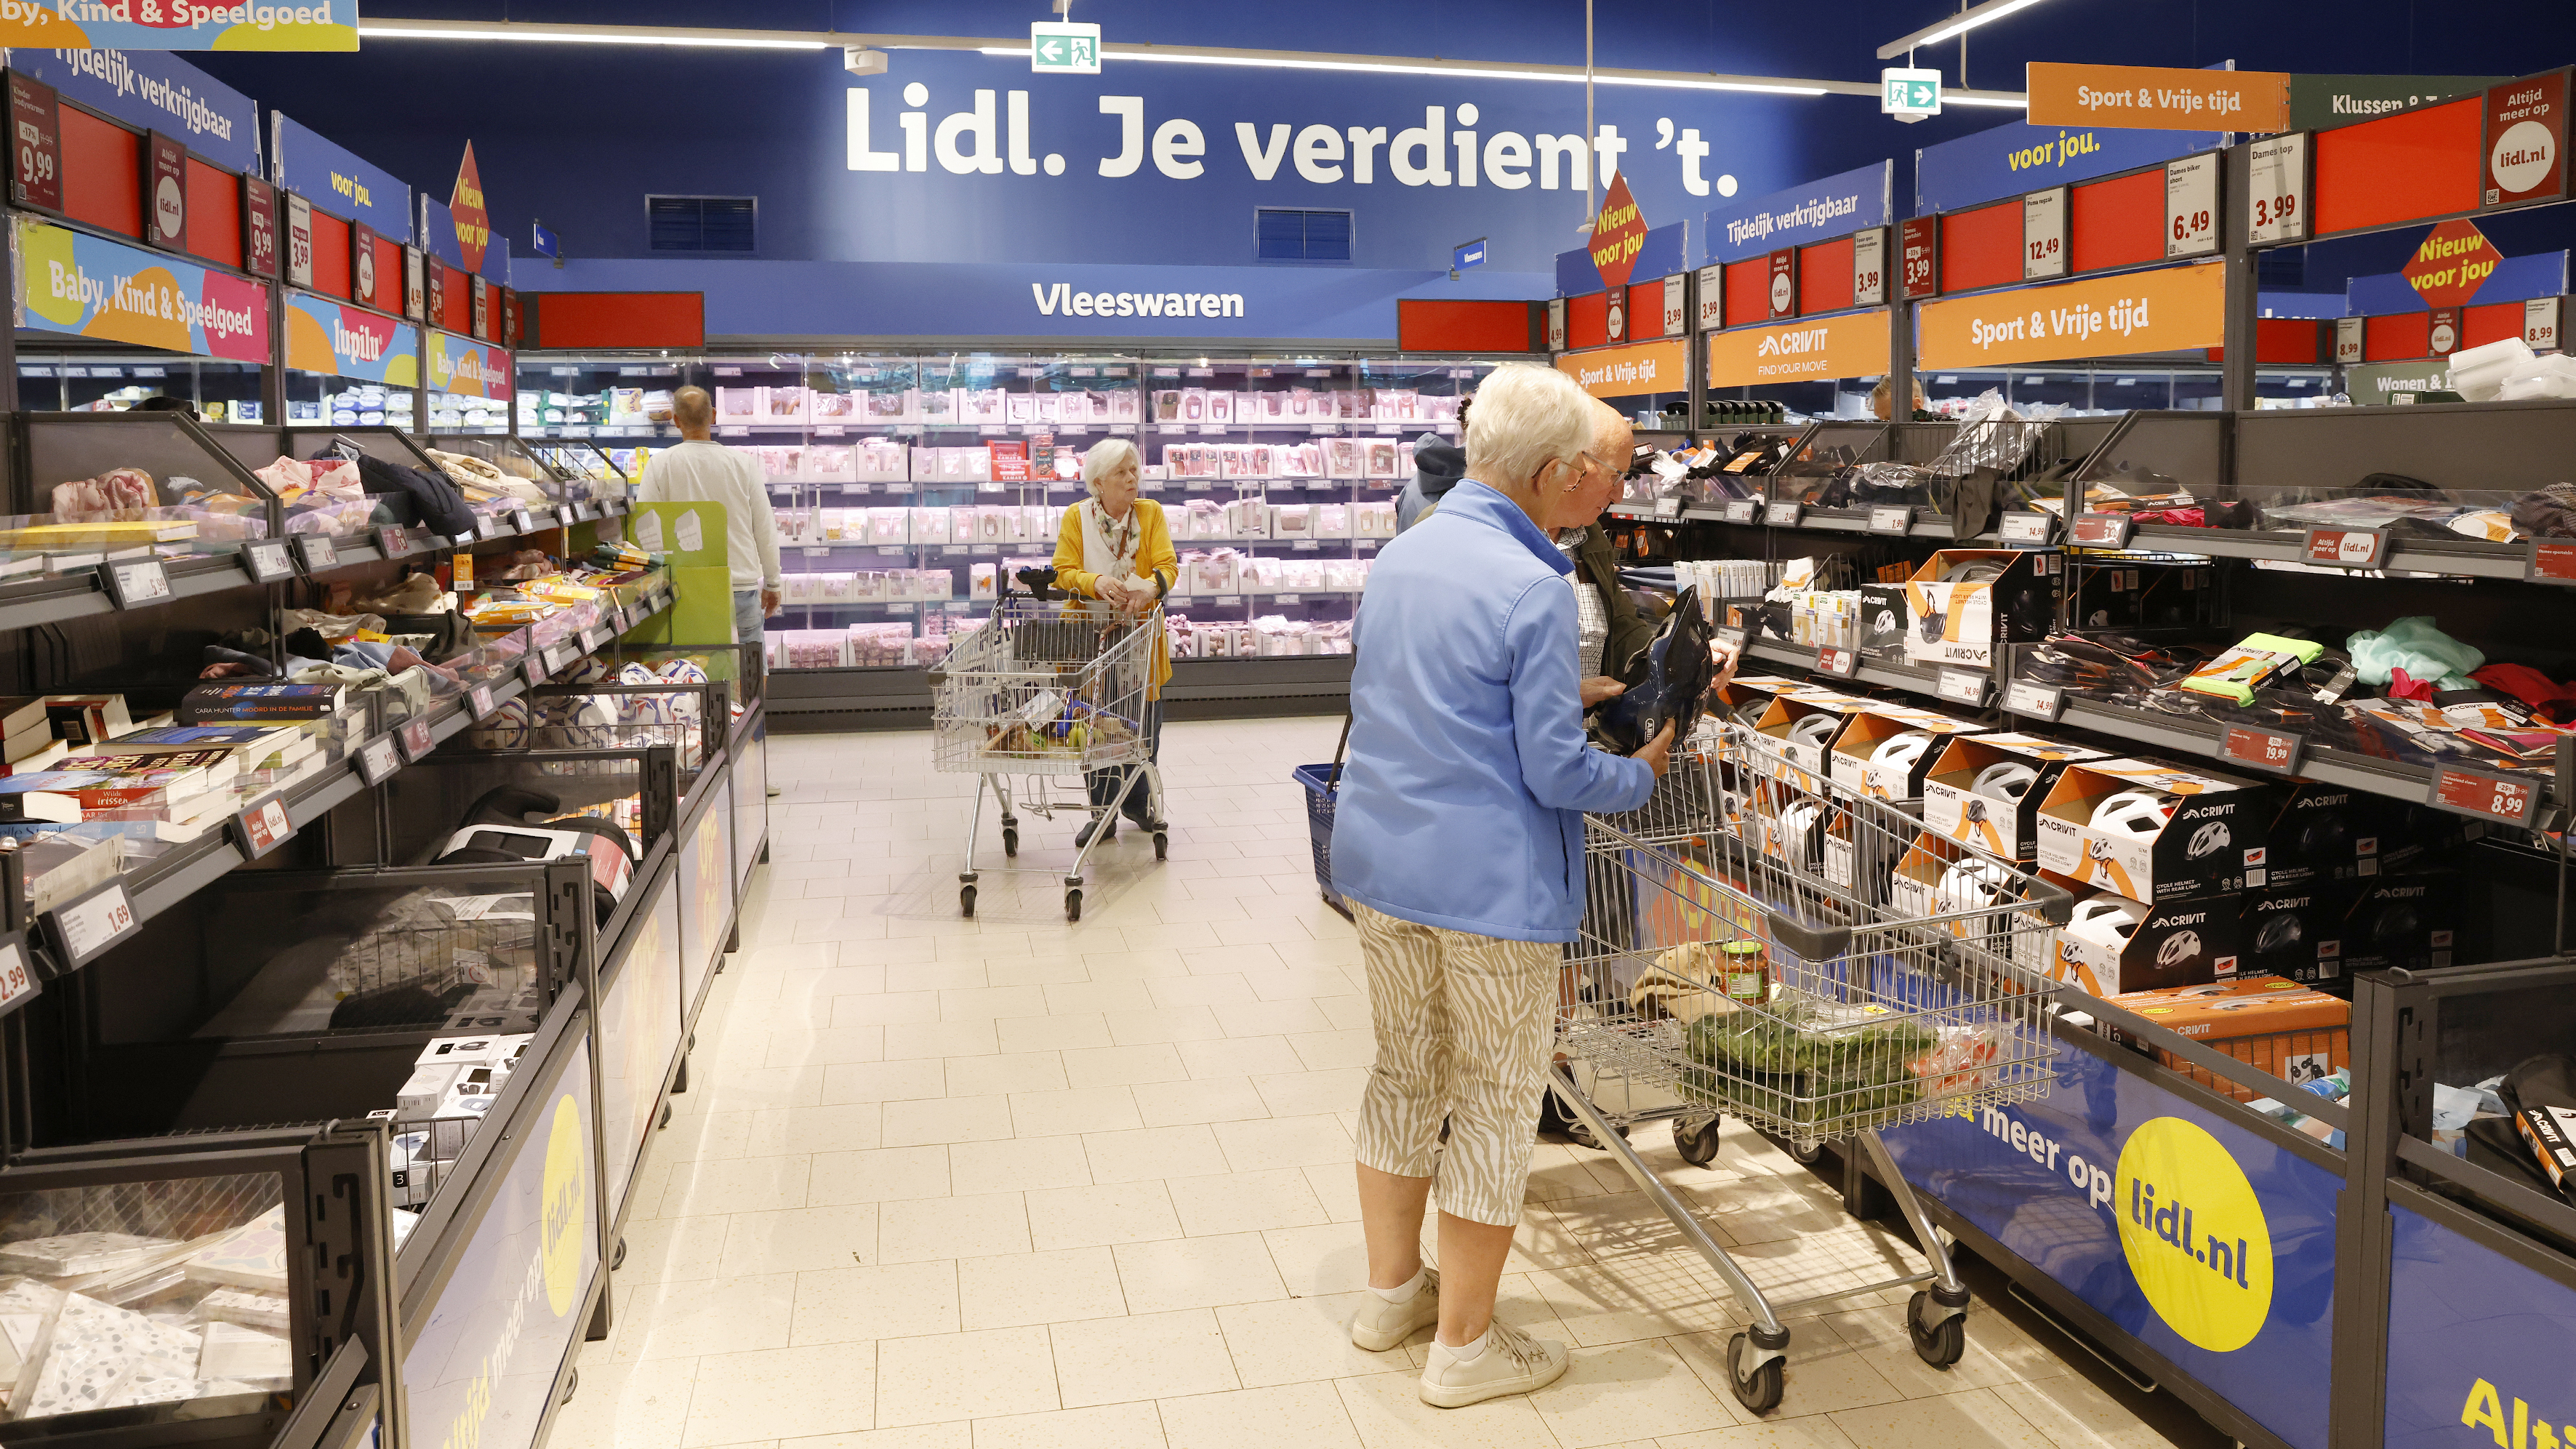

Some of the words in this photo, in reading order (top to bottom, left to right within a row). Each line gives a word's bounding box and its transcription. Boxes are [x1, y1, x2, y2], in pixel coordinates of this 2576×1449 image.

[0, 0, 48, 27] by,
[57, 0, 133, 23] Kind
[141, 1, 164, 23] &
[172, 0, 334, 31] Speelgoed
[2078, 85, 2132, 111] Sport
[2138, 88, 2153, 108] &
[2157, 89, 2204, 115] Vrije
[2208, 90, 2242, 116] tijd
[2332, 94, 2404, 115] Klussen
[2507, 87, 2543, 108] Altijd
[138, 73, 232, 142] verkrijgbaar
[2500, 105, 2532, 122] meer
[2532, 103, 2551, 116] op
[846, 81, 1066, 176] Lidl.
[1098, 95, 1205, 180] Je
[1235, 103, 1628, 190] verdient
[161, 148, 177, 164] Altijd
[2009, 141, 2055, 172] voor
[2058, 129, 2100, 166] jou.
[2252, 148, 2279, 160] Dames
[2279, 145, 2294, 155] top
[2500, 145, 2546, 169] lidl.nl
[22, 145, 53, 185] 9.99
[2170, 166, 2186, 177] Dames
[2187, 163, 2201, 172] biker
[331, 170, 353, 198] voor
[354, 174, 372, 207] jou.
[2170, 176, 2183, 185] short
[458, 178, 484, 210] Nieuw
[159, 197, 180, 217] lidl.nl
[2255, 193, 2296, 227] 3.99
[1598, 203, 1637, 235] Nieuw
[1727, 220, 1774, 247] Tijdelijk
[1776, 194, 1858, 230] verkrijgbaar
[2172, 209, 2210, 241] 6.49
[254, 229, 272, 257] 9.99
[456, 222, 474, 244] voor
[476, 223, 489, 252] jou
[293, 241, 309, 268] 3.99
[1464, 250, 1483, 263] Vleeswaren
[1593, 244, 1621, 268] voor
[1622, 231, 1644, 264] jou
[2029, 237, 2059, 260] 12.49
[2419, 233, 2484, 263] Nieuw
[1906, 259, 1930, 284] 3.99
[2410, 263, 2457, 292] voor
[2457, 258, 2494, 289] jou
[1858, 270, 1879, 293] 3.99
[48, 260, 109, 314] Baby,
[113, 273, 156, 312] Kind
[160, 284, 173, 313] &
[176, 291, 253, 340] Speelgoed
[1032, 282, 1245, 318] Vleeswaren
[1774, 287, 1789, 297] lidl.nl
[1666, 308, 1682, 326] 3.99
[1702, 301, 1717, 320] 3.99
[1972, 315, 2025, 350] Sport
[2029, 312, 2045, 339] &
[2050, 302, 2103, 342] Vrije
[2107, 297, 2150, 337] tijd
[1550, 328, 1562, 343] 4.99
[1780, 328, 1828, 355] CRIVIT
[2528, 326, 2553, 342] 8.99
[2340, 342, 2358, 356] 8.99
[437, 352, 457, 380] Baby,
[457, 356, 473, 379] Kind
[478, 361, 507, 389] Speelgoed
[1580, 366, 1605, 388] Sport
[1605, 366, 1613, 382] &
[1614, 361, 1637, 385] Vrije
[1638, 359, 1656, 384] tijd
[1758, 364, 1778, 376] FIND
[1778, 362, 1801, 374] YOUR
[1801, 359, 1828, 373] MOVE
[2376, 377, 2427, 393] Wonen
[2429, 374, 2442, 391] &
[1741, 510, 1752, 520] 1.49
[1784, 512, 1796, 522] 2.00
[1892, 518, 1904, 530] 1.99
[2029, 526, 2045, 538] 14.99
[2317, 537, 2335, 547] Altijd
[2327, 546, 2337, 555] op
[2343, 541, 2370, 554] lidl.nl
[150, 577, 168, 597] 5.99
[1869, 596, 1887, 606] CRIVIT
[1834, 657, 1847, 667] lidl.nl
[1944, 646, 1973, 660] CRIVIT
[1964, 686, 1980, 697] 14.99
[2036, 699, 2053, 711] 14.99
[2266, 746, 2288, 760] 19.99
[1839, 756, 1858, 770] CRIVIT
[97, 796, 128, 806] irissen
[1935, 786, 1957, 800] CRIVIT
[2314, 793, 2349, 808] CRIVIT
[2200, 803, 2236, 818] CRIVIT
[2490, 794, 2524, 815] 8.99
[268, 811, 284, 829] lidl.nl
[2050, 821, 2077, 838] CRIVIT
[2052, 852, 2069, 863] HELMET
[2138, 846, 2148, 855] S/M
[2050, 856, 2060, 865] REAR
[2058, 859, 2073, 869] LIGHT
[2287, 867, 2309, 875] HELMET
[2156, 882, 2172, 891] CYCLE
[2172, 879, 2195, 888] HELMET
[2184, 883, 2202, 891] LIGHT
[2391, 886, 2426, 898] CRIVIT
[2275, 896, 2311, 910] CRIVIT
[108, 904, 129, 933] 1.69
[2170, 912, 2207, 928] CRIVIT
[2178, 1023, 2212, 1036] CRIVIT
[2535, 1119, 2562, 1144] CRIVIT
[1983, 1106, 2061, 1171] meer
[2068, 1155, 2113, 1210] op
[396, 1173, 404, 1185] 3
[545, 1154, 582, 1258] lidl.nl
[2132, 1177, 2249, 1291] lidl.nl
[444, 1355, 491, 1449] ltijd
[490, 1302, 525, 1390] meer
[523, 1245, 544, 1304] op
